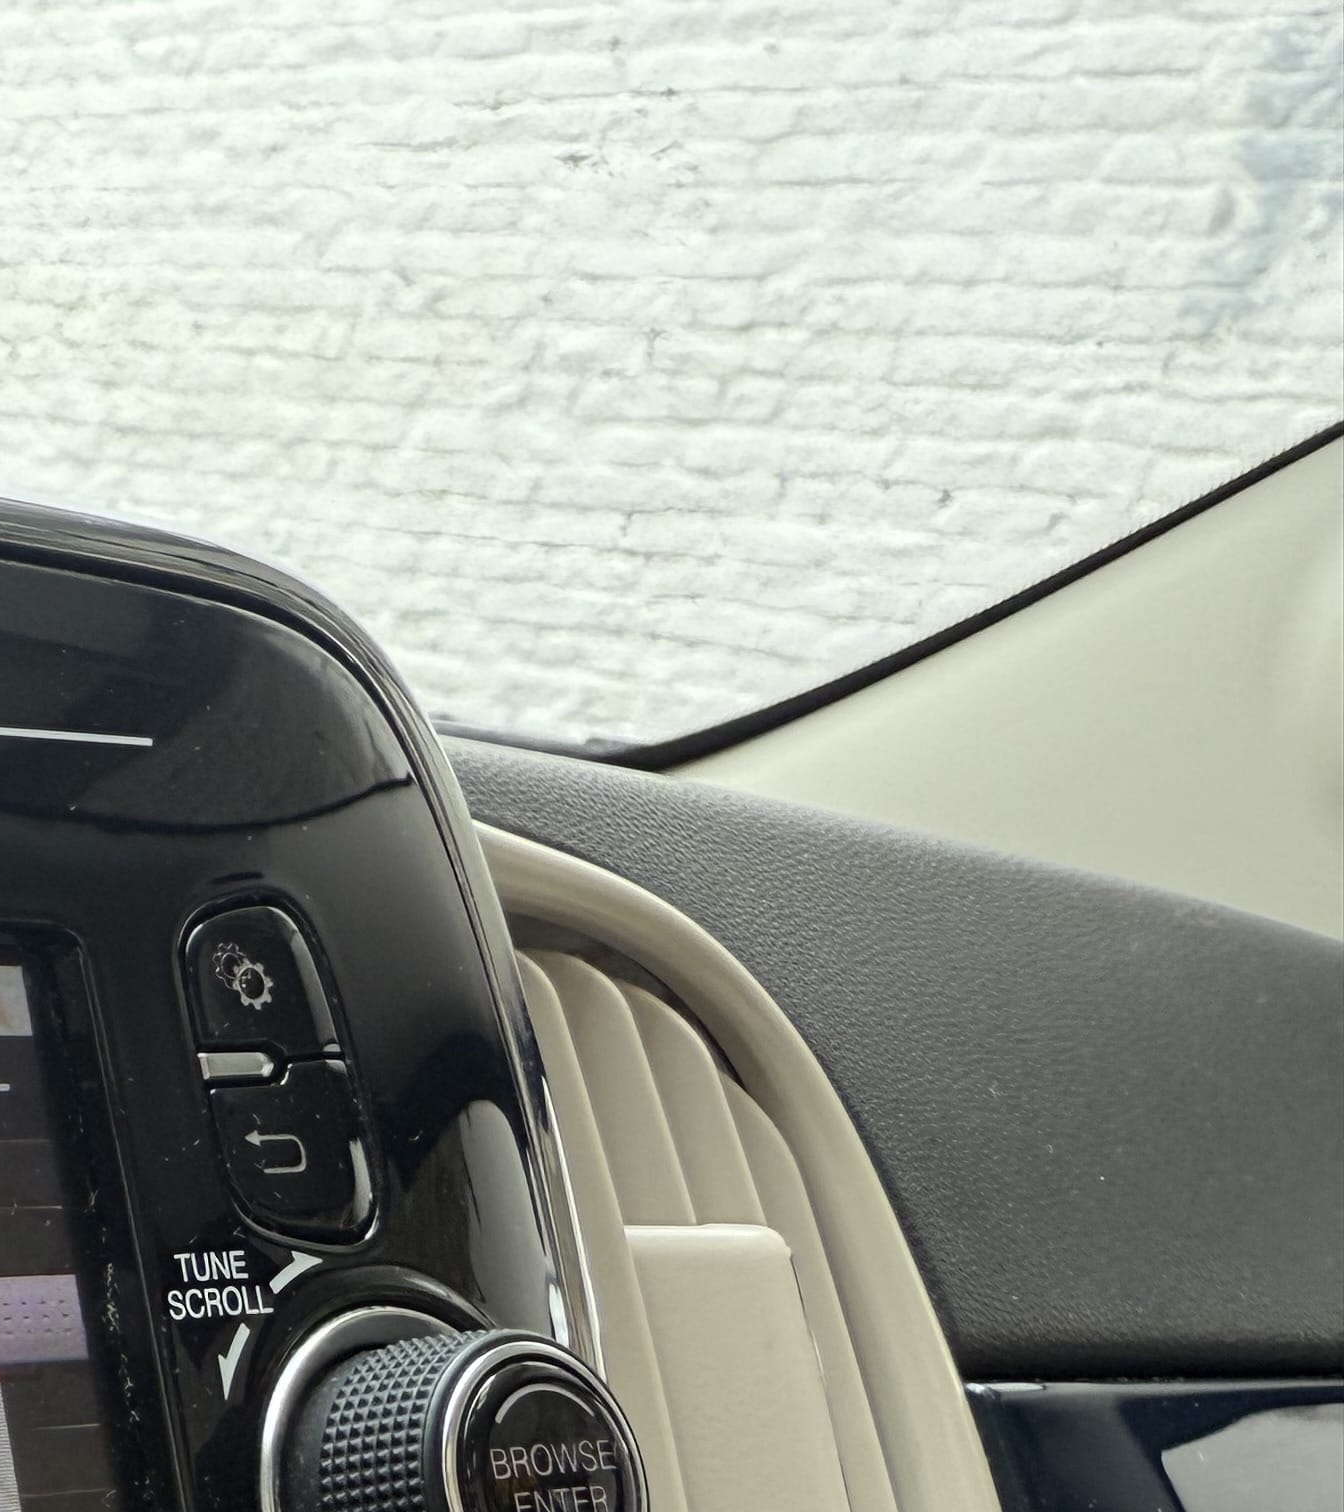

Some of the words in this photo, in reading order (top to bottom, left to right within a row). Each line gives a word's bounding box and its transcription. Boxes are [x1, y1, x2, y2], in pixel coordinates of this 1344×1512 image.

[173, 1250, 250, 1283] TUNE
[167, 1285, 274, 1321] SCROLL
[490, 1439, 618, 1480] BROWSE
